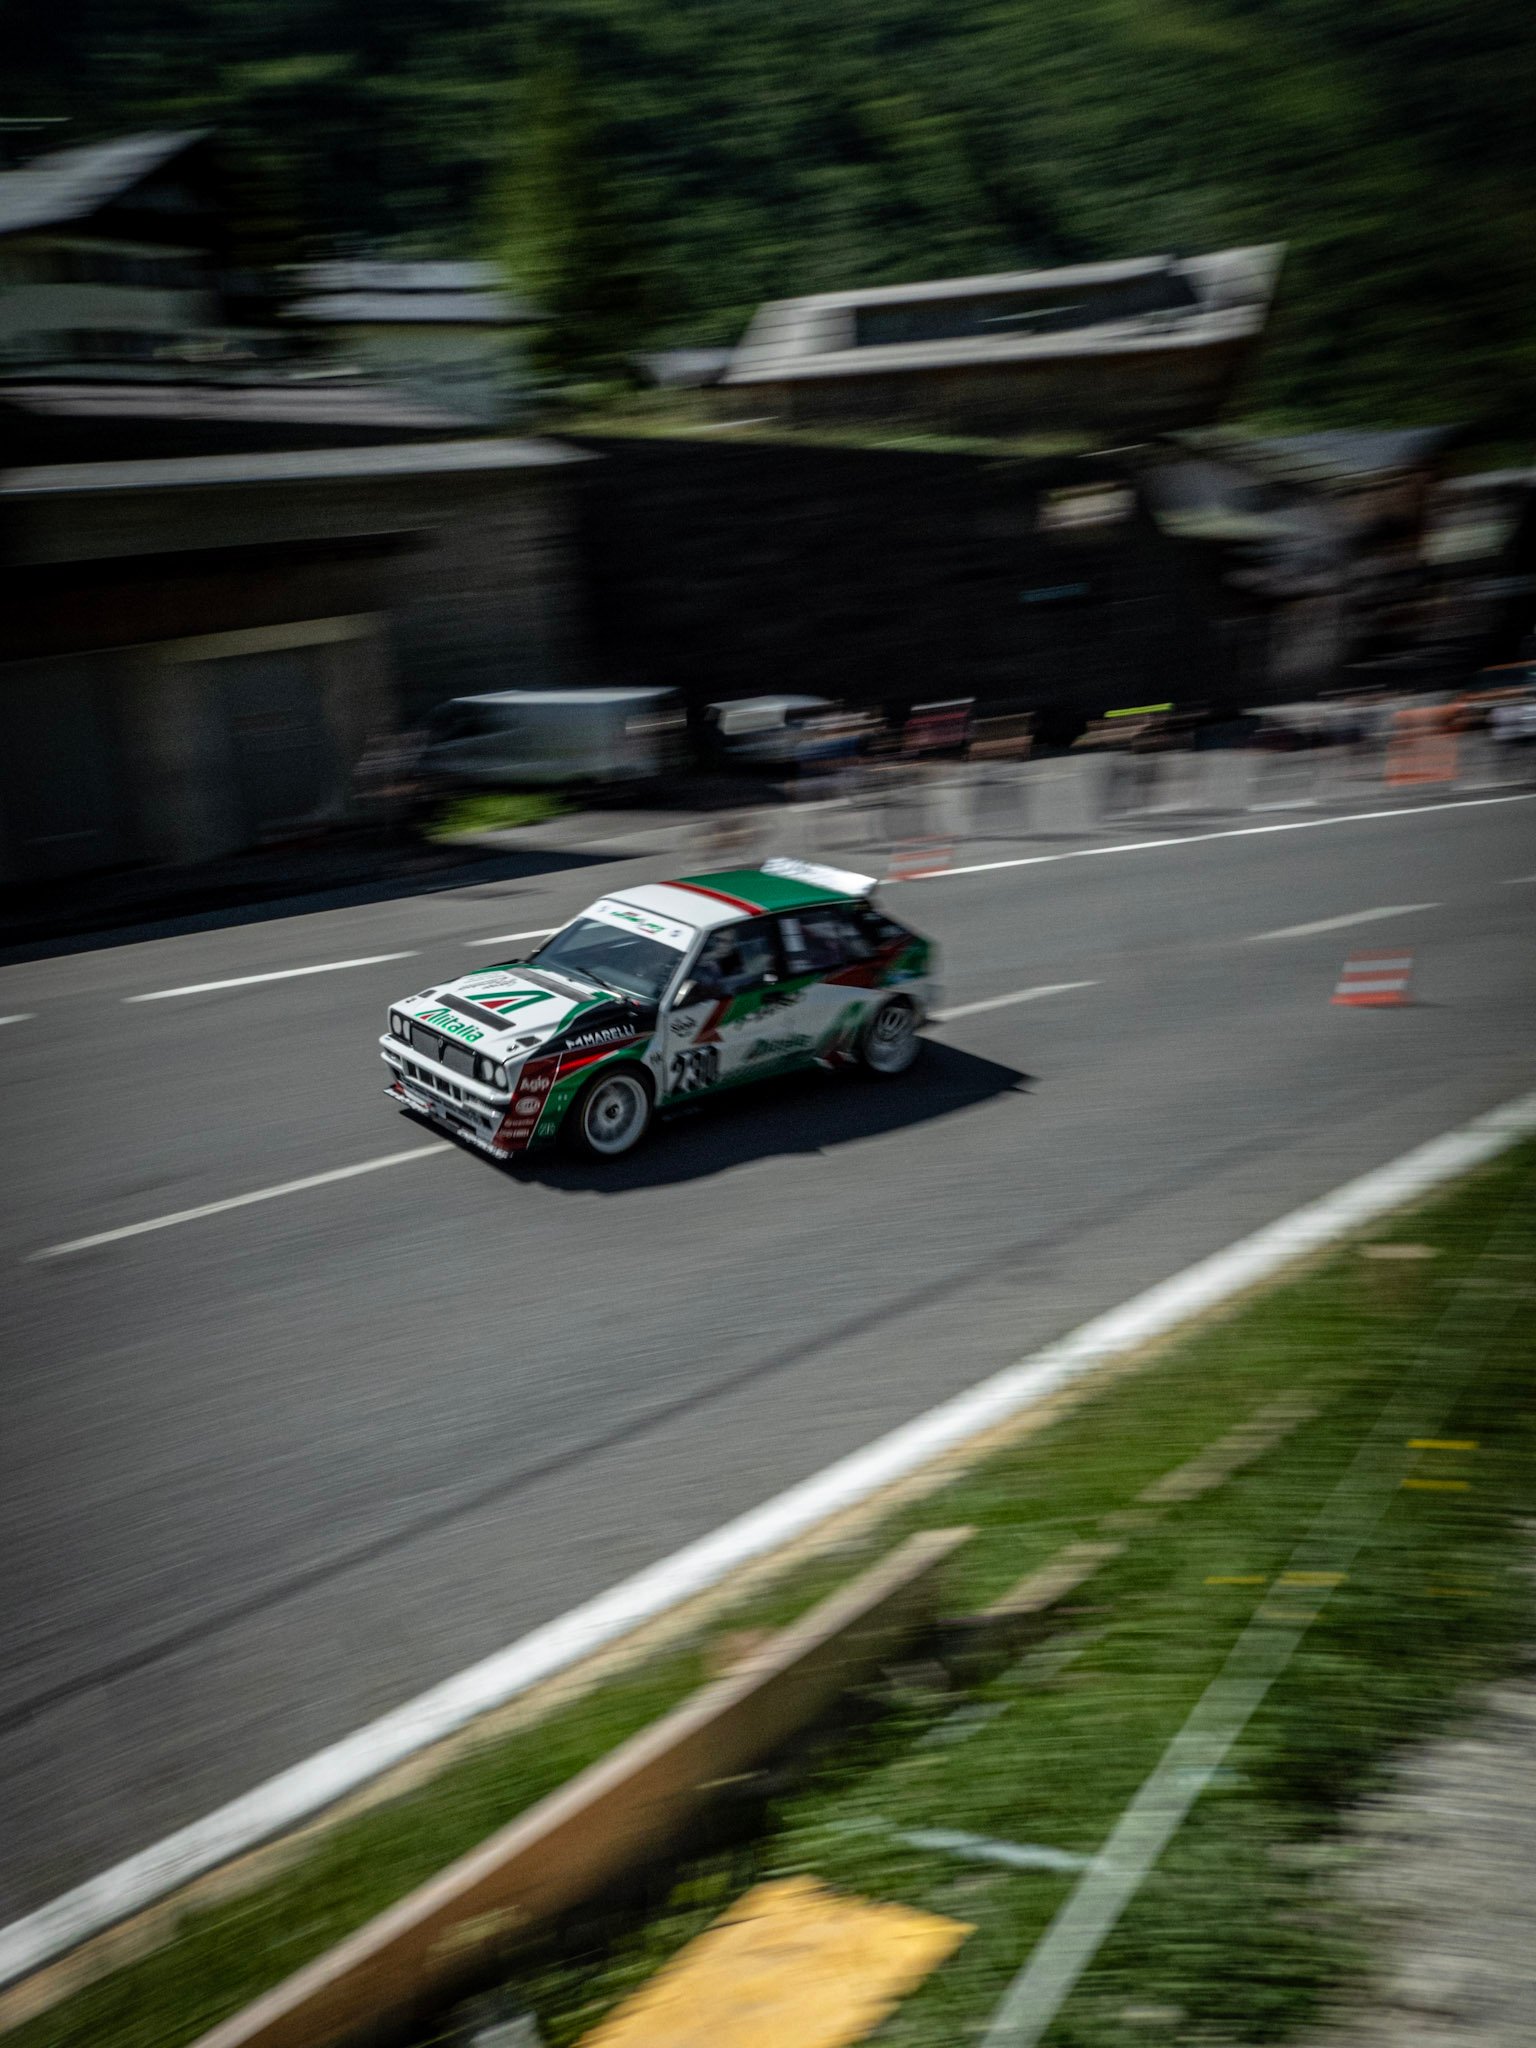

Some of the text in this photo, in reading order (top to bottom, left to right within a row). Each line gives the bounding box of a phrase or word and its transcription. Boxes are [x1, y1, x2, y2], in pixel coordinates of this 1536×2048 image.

[415, 1007, 485, 1043] Alitalia
[582, 1023, 636, 1046] MARELLI
[520, 1075, 550, 1093] Agip
